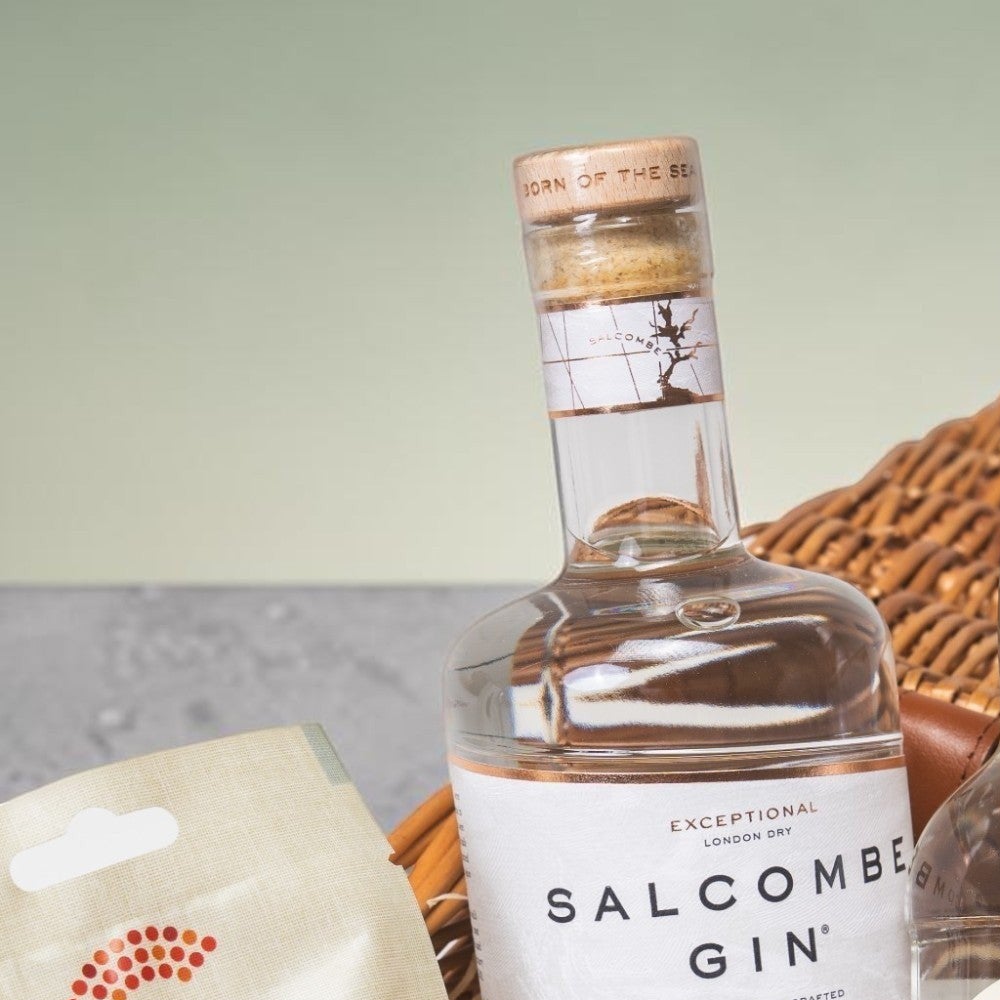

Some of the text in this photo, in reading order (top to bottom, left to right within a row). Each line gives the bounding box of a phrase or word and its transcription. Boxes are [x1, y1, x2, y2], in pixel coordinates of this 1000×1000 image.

[578, 171, 607, 188] OF
[618, 166, 661, 182] THE
[670, 802, 818, 833] EXCEPTIONAL
[704, 827, 793, 847] LONDON DRY
[546, 836, 907, 924] SALCOMBE
